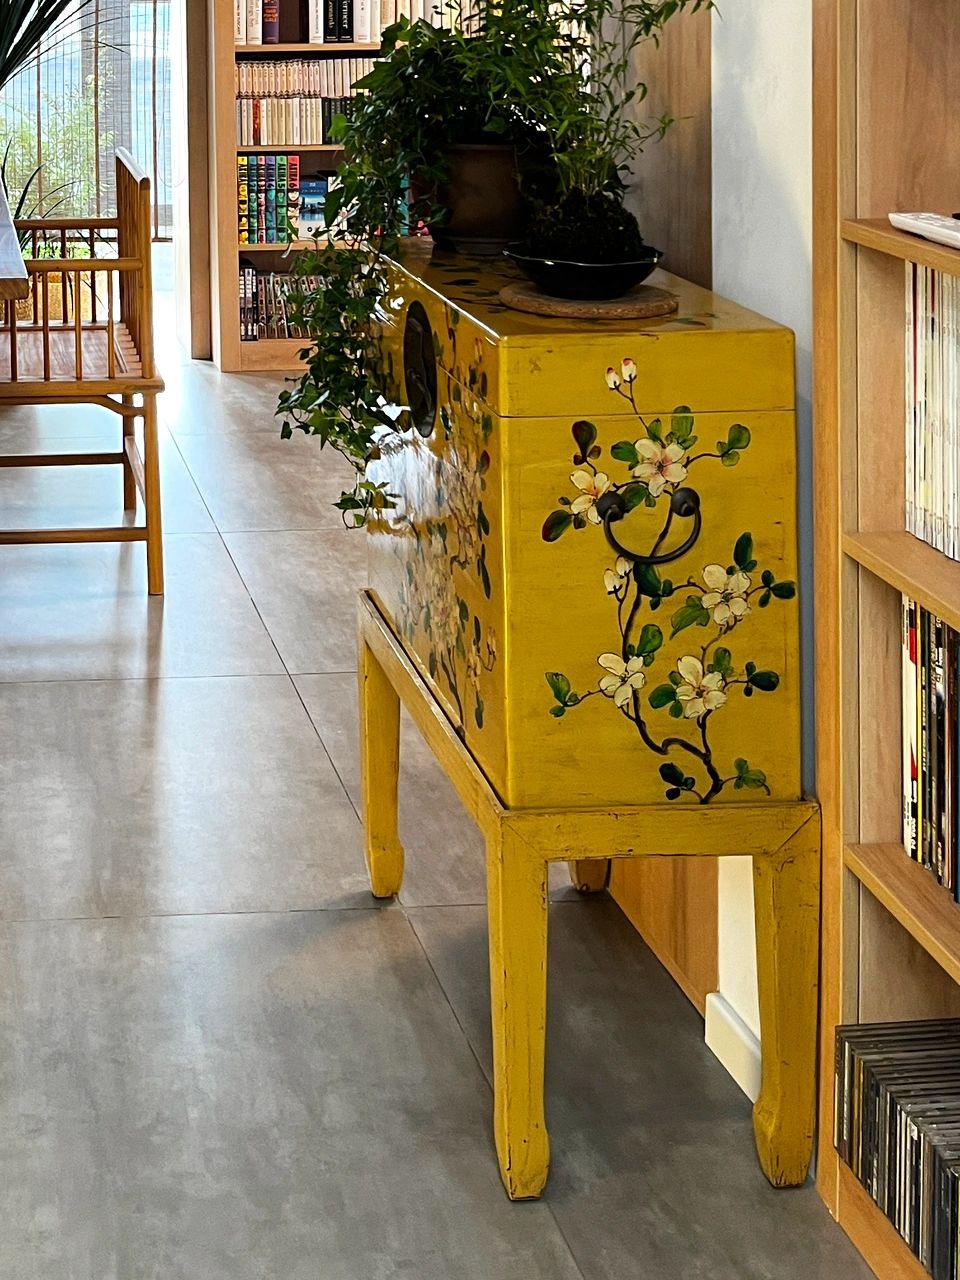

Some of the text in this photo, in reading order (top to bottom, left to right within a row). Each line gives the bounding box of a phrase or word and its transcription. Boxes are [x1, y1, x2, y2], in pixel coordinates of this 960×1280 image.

[266, 163, 275, 182] AKIRA
[277, 163, 287, 182] AKIRA
[288, 163, 298, 182] AKIRA
